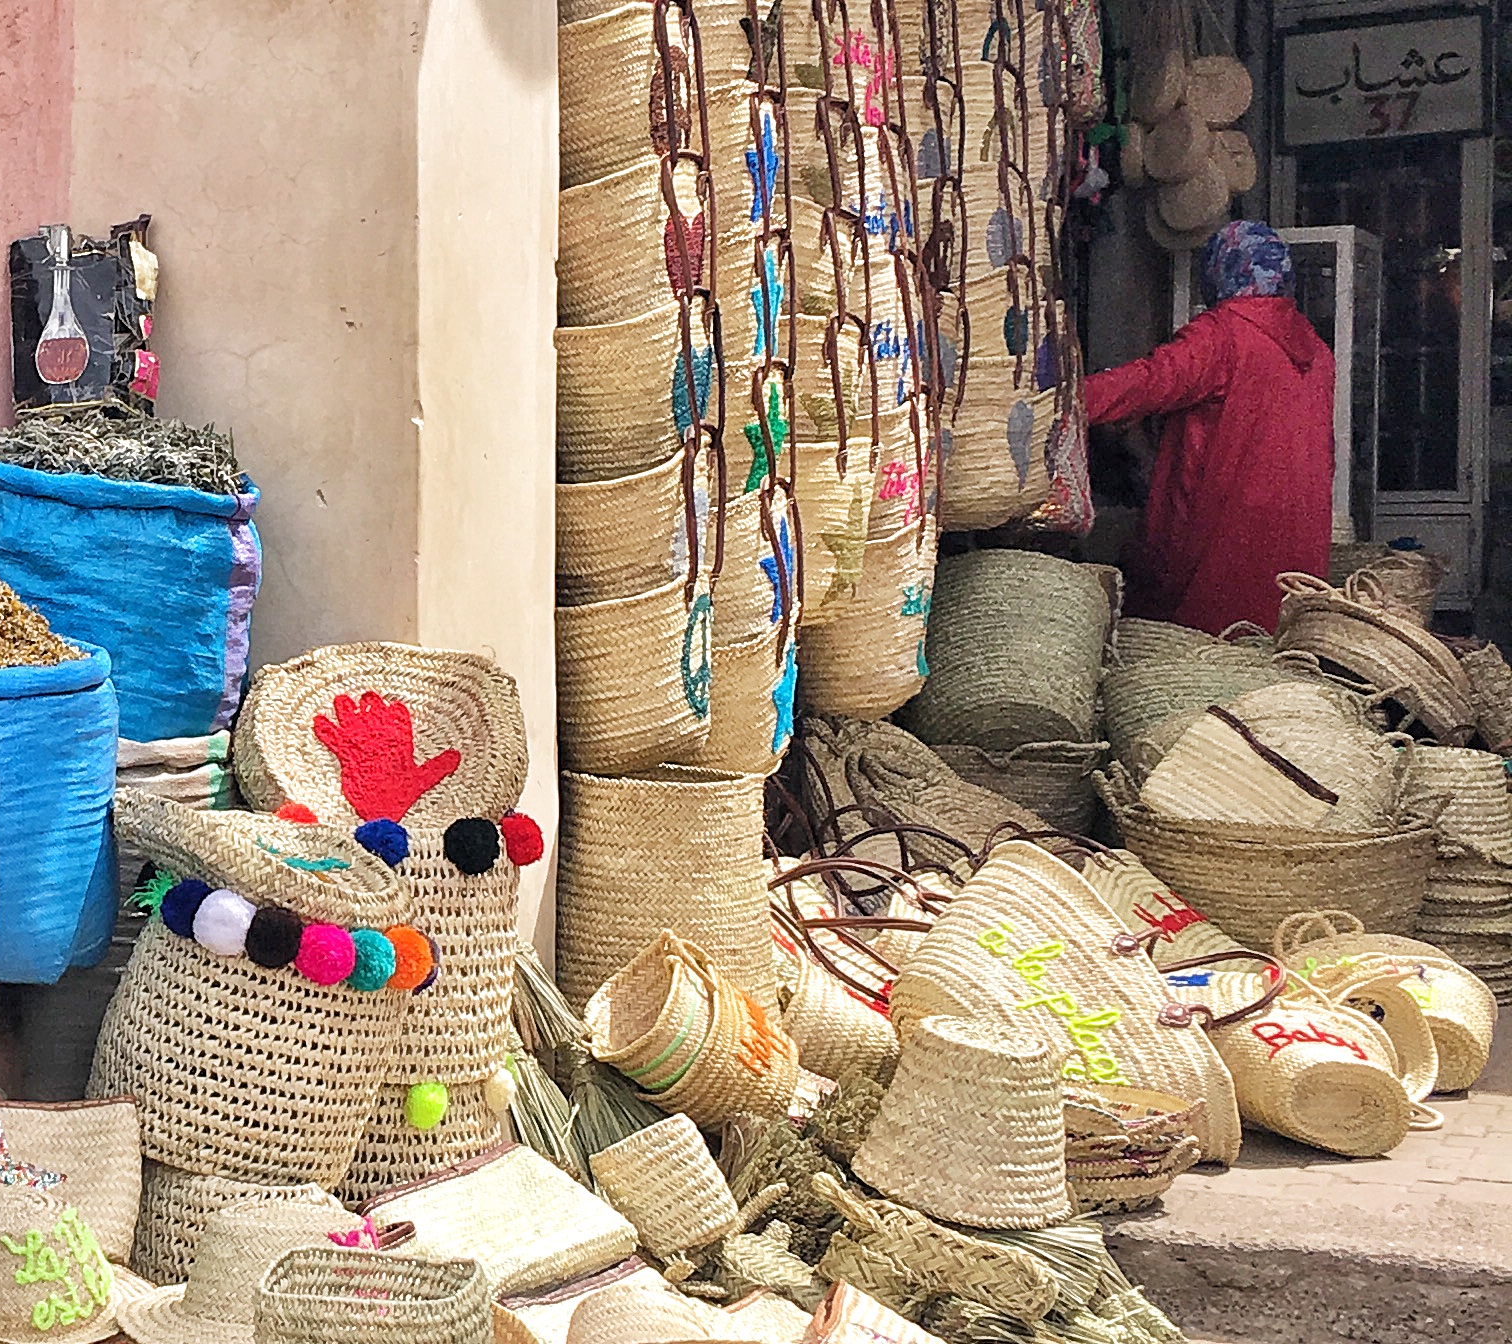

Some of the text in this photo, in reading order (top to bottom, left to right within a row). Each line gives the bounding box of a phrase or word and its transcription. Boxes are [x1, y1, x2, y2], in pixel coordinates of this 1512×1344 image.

[1294, 41, 1472, 105] عشاب
[1363, 90, 1421, 136] 37
[1251, 1020, 1368, 1062] Baby
